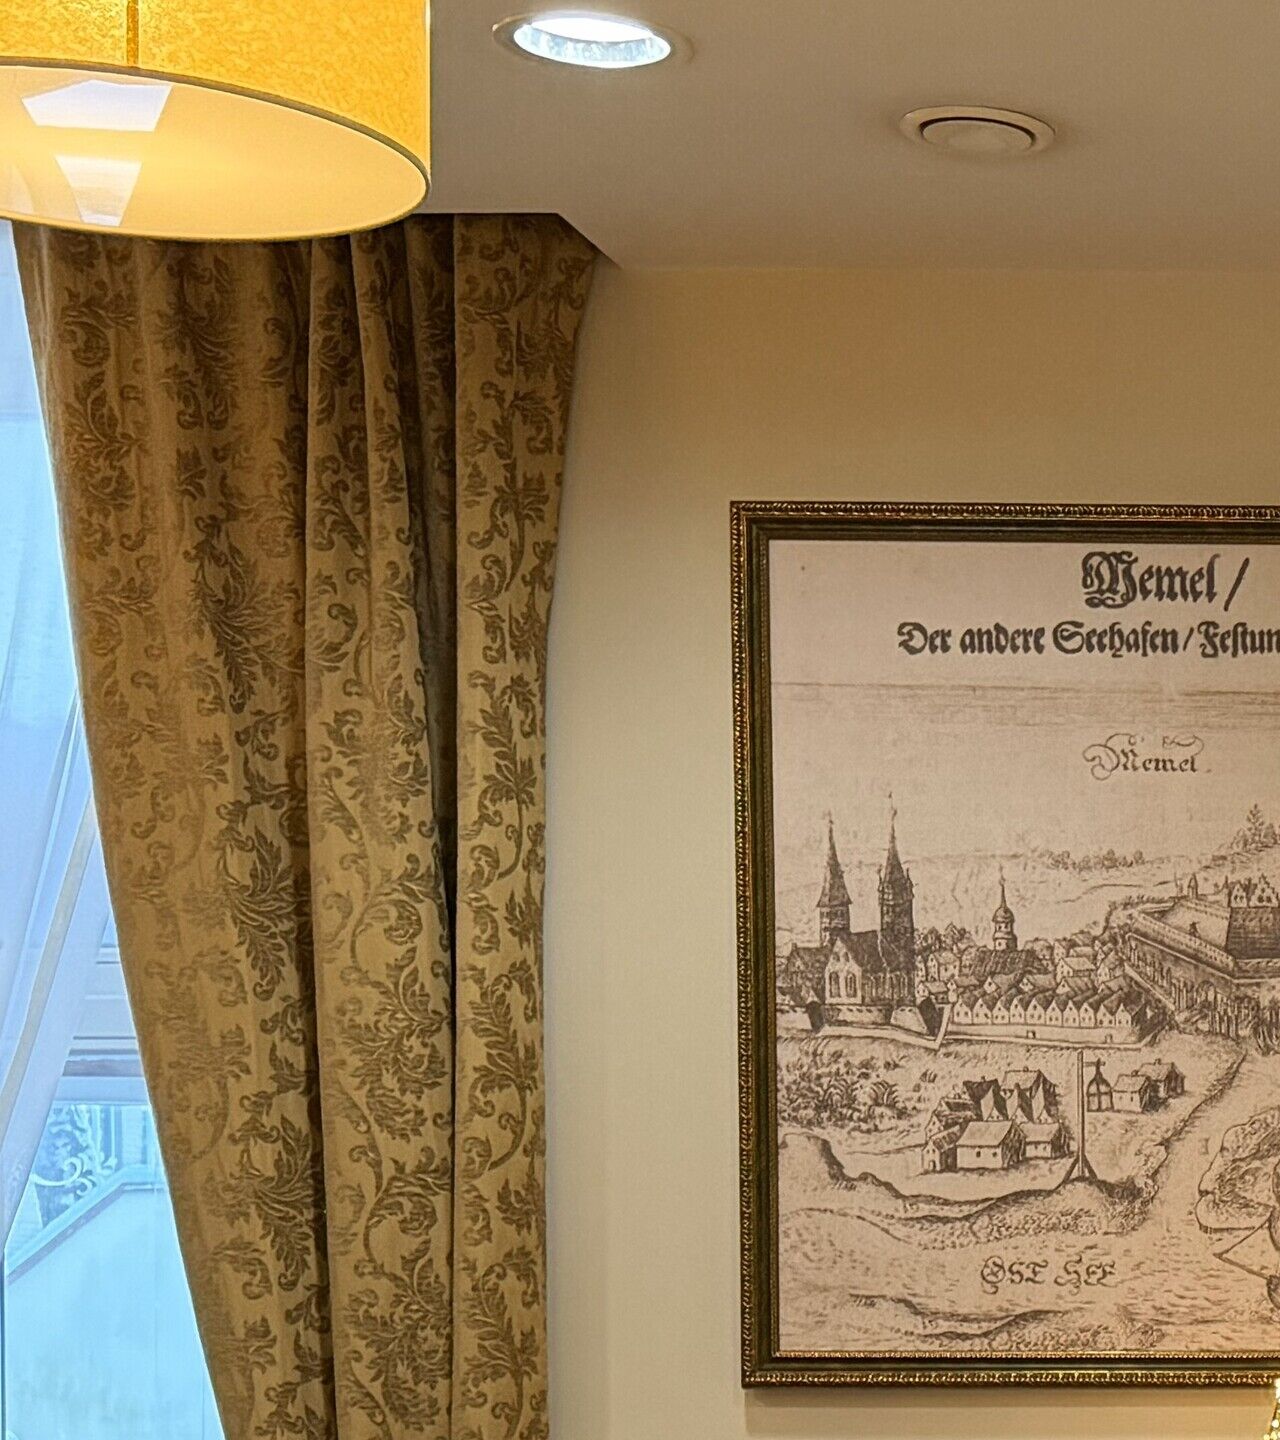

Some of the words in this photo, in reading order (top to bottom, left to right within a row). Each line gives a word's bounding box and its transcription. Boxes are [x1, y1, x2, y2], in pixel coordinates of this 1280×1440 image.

[1082, 551, 1219, 608] Memel
[898, 622, 952, 655] Der
[960, 622, 1046, 655] andere
